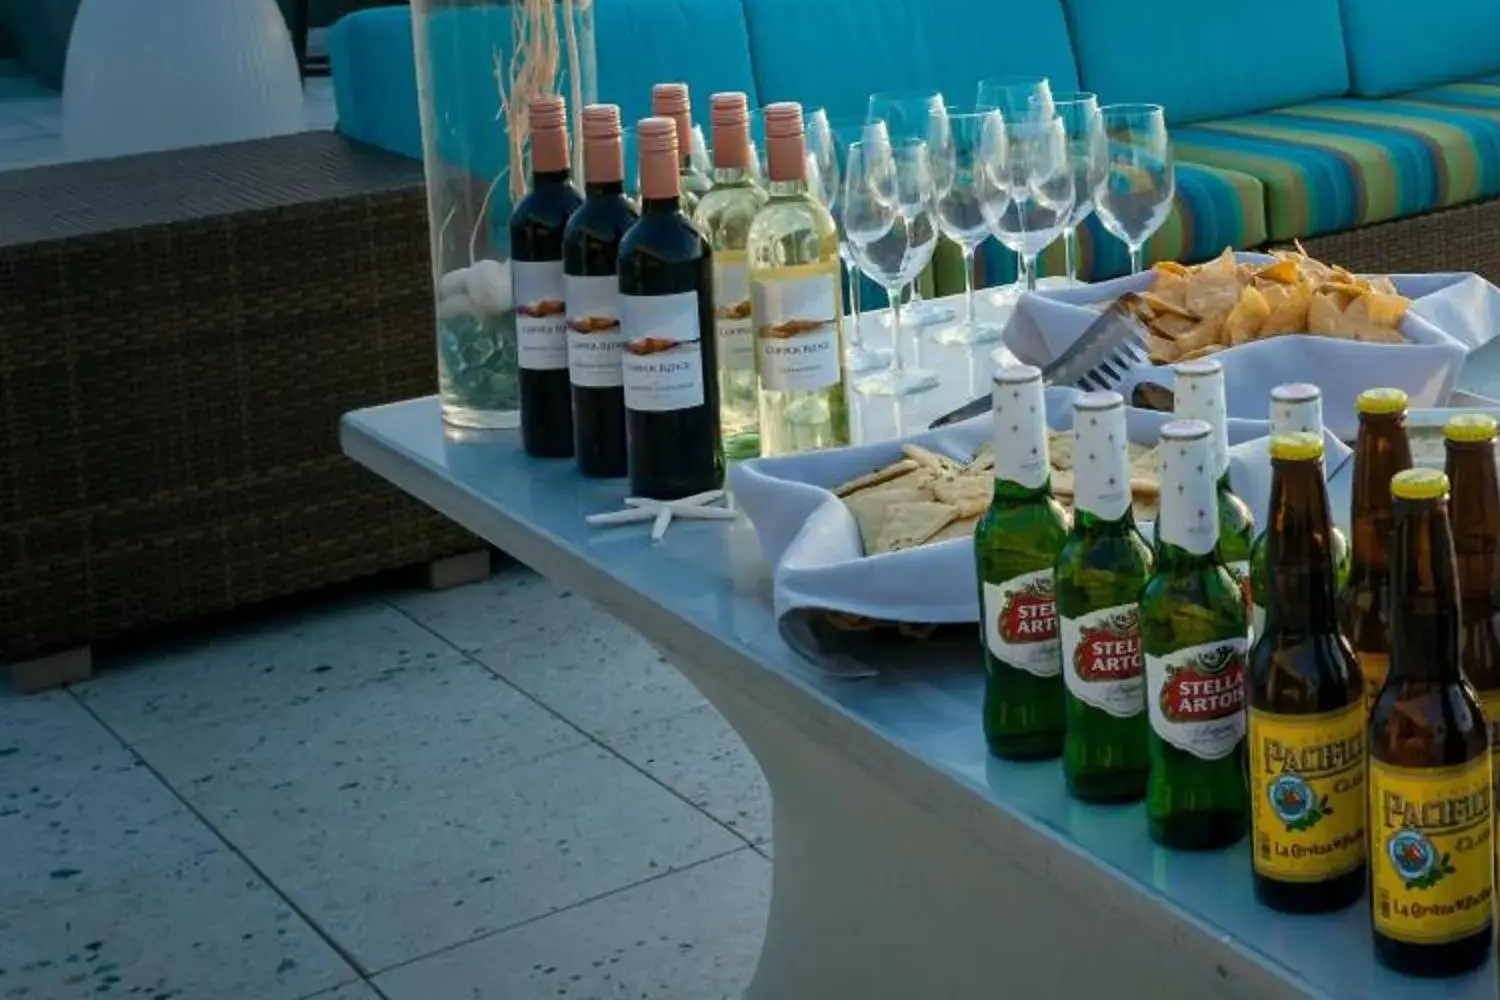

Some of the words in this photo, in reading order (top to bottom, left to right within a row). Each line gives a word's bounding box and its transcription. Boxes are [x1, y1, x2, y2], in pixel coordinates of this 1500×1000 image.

[1018, 603, 1057, 619] STEL
[1017, 618, 1057, 634] ART
[1091, 655, 1142, 671] ARTO
[1179, 671, 1244, 696] STELLA
[1179, 686, 1245, 713] ARTOIS
